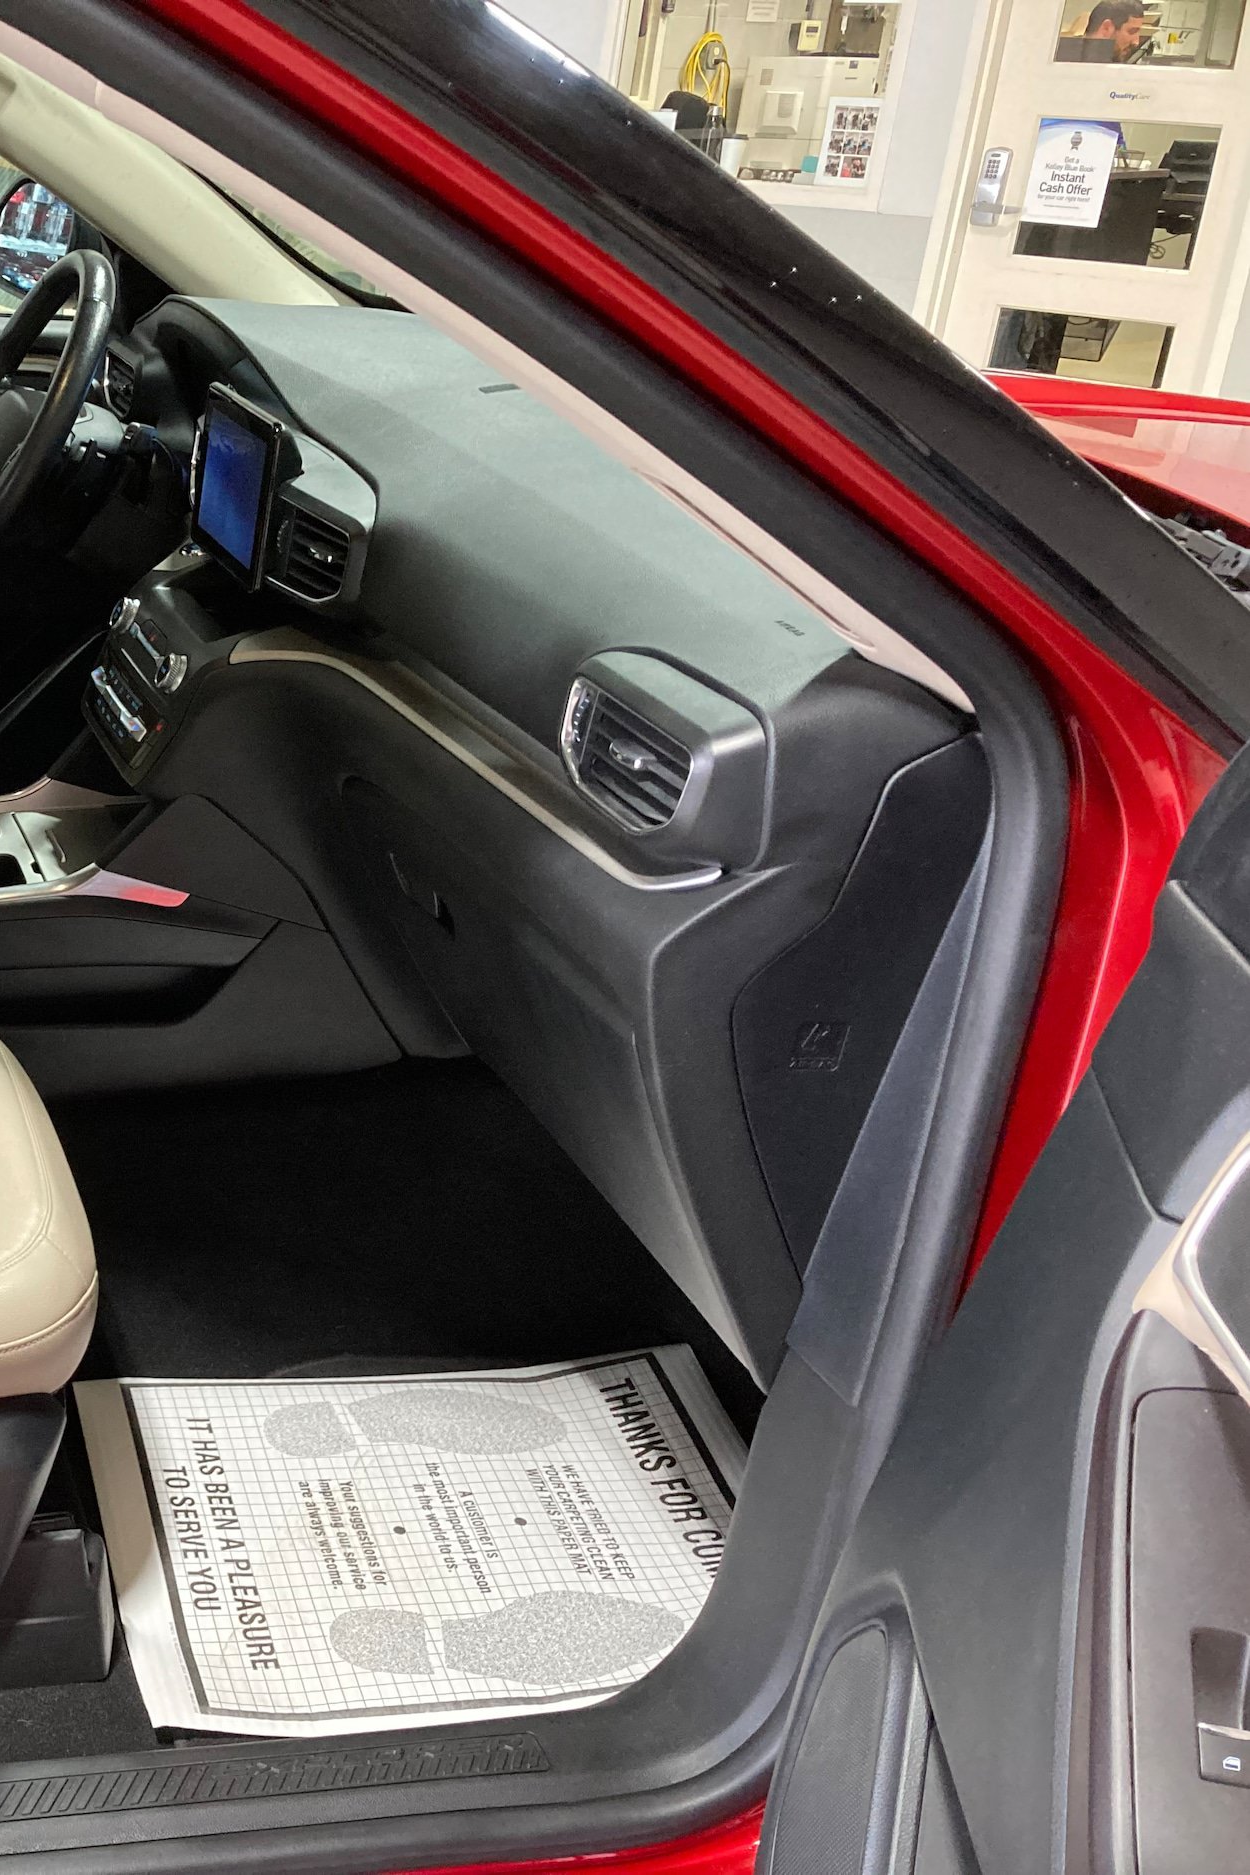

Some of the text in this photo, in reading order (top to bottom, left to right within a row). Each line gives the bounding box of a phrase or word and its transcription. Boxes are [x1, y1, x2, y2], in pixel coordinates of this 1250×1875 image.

[1039, 182, 1093, 196] Cash Offer
[1051, 171, 1086, 183] Instant
[458, 1490, 473, 1498] A
[599, 1377, 677, 1473] THANKS
[651, 1477, 708, 1523] FOR
[163, 1466, 221, 1610] TO SERVE YOU
[186, 1418, 281, 1670] IT HAS BEEN A PLEASURE
[299, 1481, 343, 1590] are always welcome.
[336, 1531, 352, 1548] our
[344, 1552, 367, 1590] service
[339, 1480, 388, 1586] Your suggestions for
[413, 1483, 458, 1573] in the world to us.
[425, 1462, 492, 1594] the most important person
[463, 1500, 494, 1546] customer
[526, 1468, 592, 1575] WITH THIS PAPER MAT
[542, 1464, 615, 1580] YOUR CARPETING CLEAN
[561, 1464, 635, 1580] WE HAVE TRIED TO KEEP
